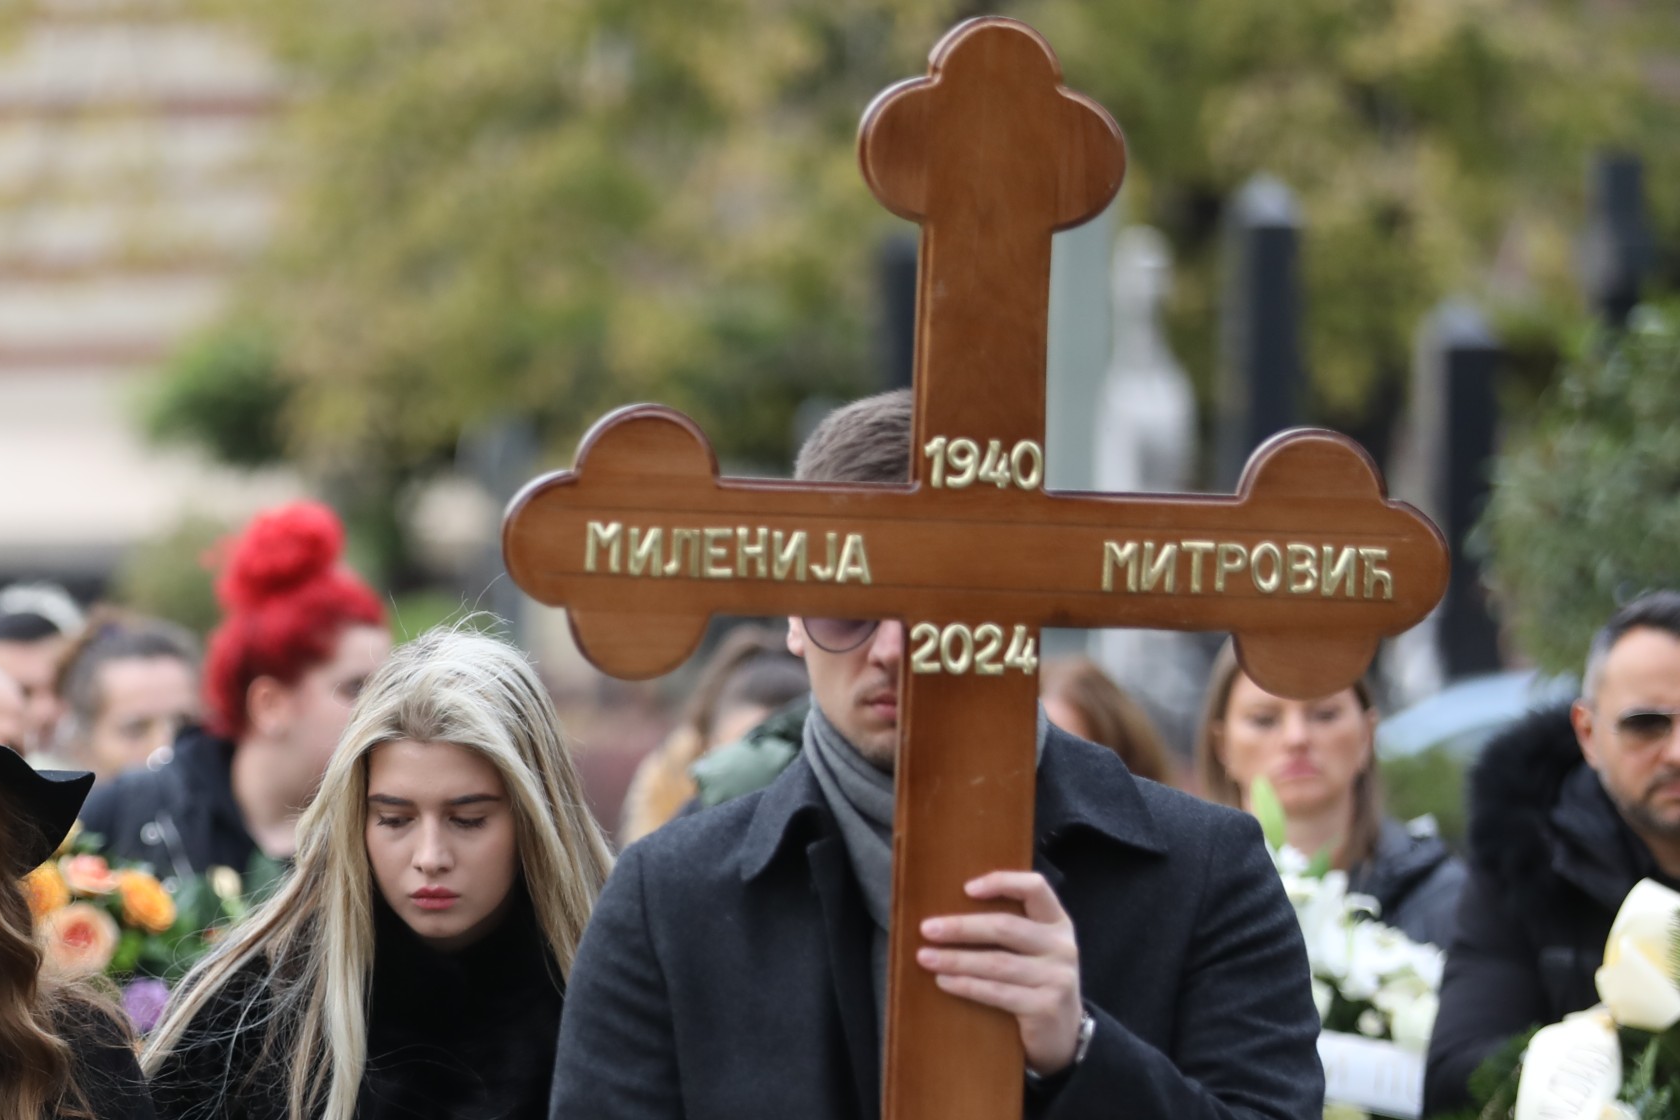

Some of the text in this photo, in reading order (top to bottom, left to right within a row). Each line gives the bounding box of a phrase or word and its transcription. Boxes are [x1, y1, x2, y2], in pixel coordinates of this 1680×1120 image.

[923, 435, 1046, 491] 1940
[584, 519, 1394, 600] МИЛЕНИЈА МИТРОВИЋ
[909, 622, 1040, 677] 2024
